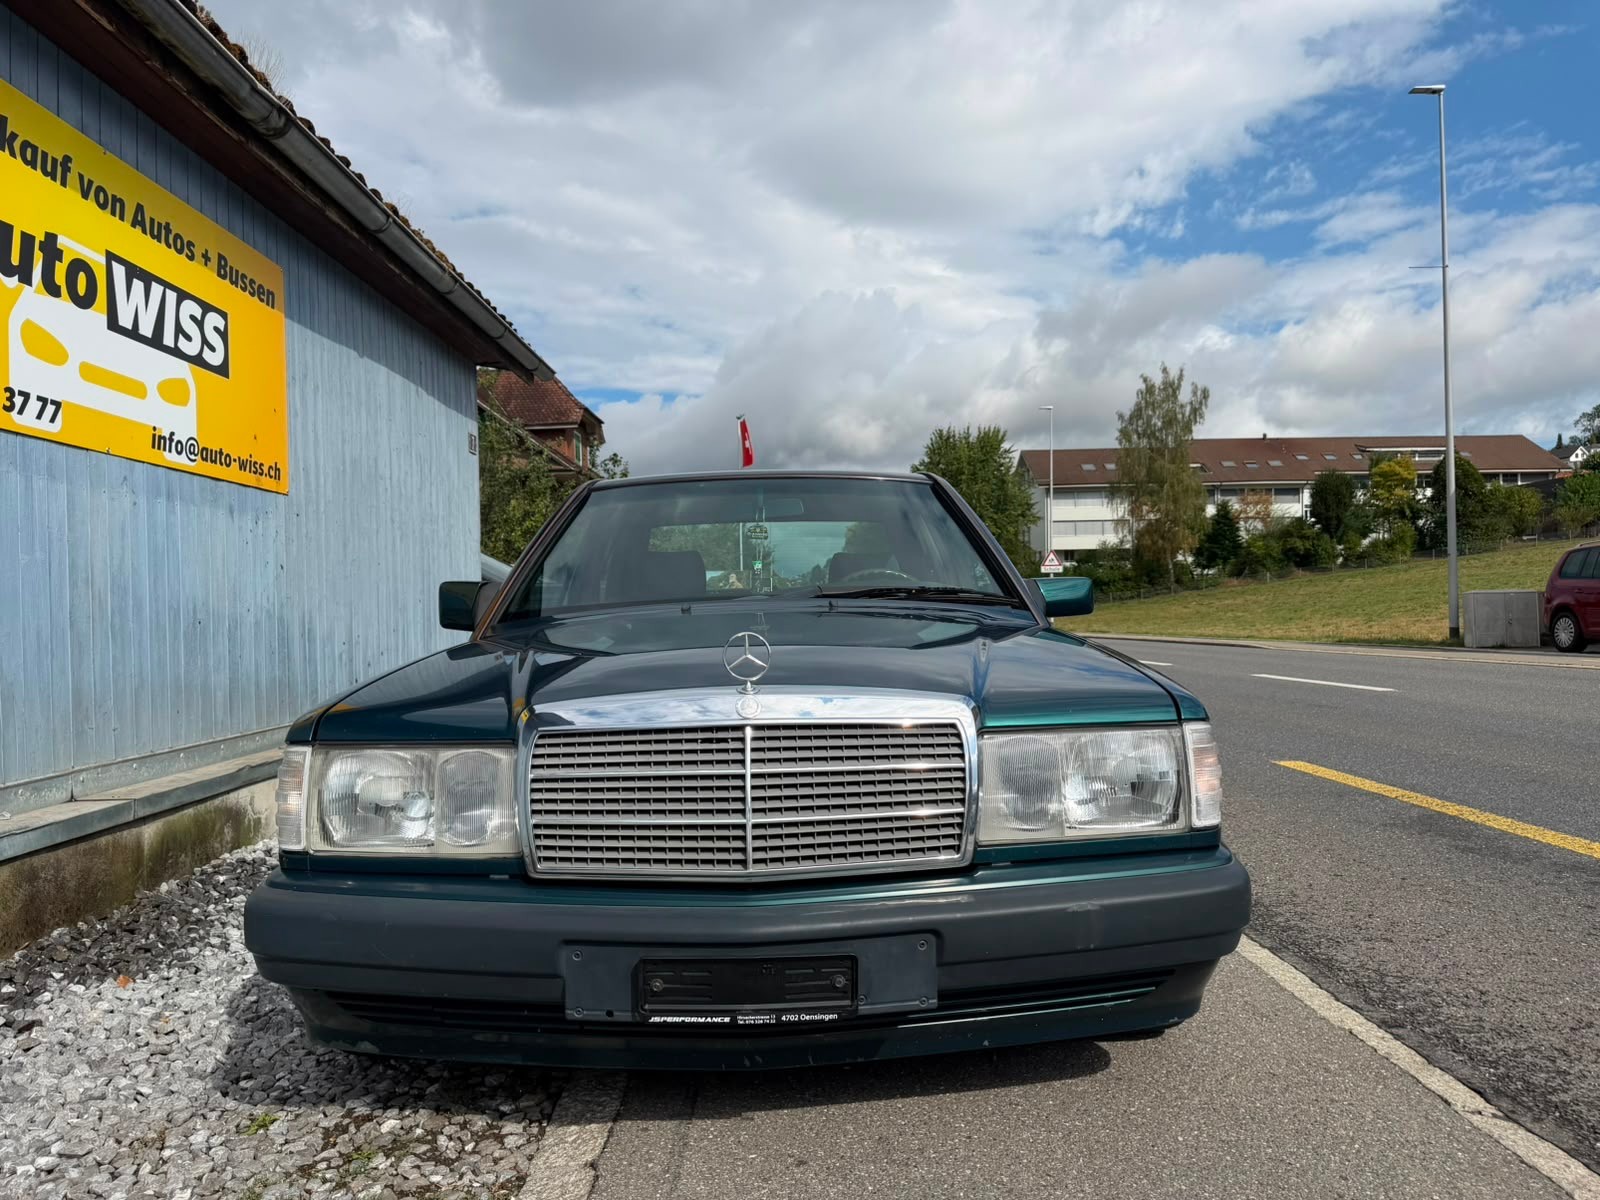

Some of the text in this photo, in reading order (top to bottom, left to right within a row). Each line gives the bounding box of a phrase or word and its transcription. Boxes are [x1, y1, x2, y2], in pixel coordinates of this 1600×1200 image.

[0, 113, 275, 309] kauf von Autos + Bussen
[112, 266, 226, 366] WISS
[2, 386, 62, 424] 37 77
[151, 426, 281, 481] info@auto-wiss.ch
[781, 1014, 799, 1022] 4702
[800, 1013, 838, 1022] Oensingen
